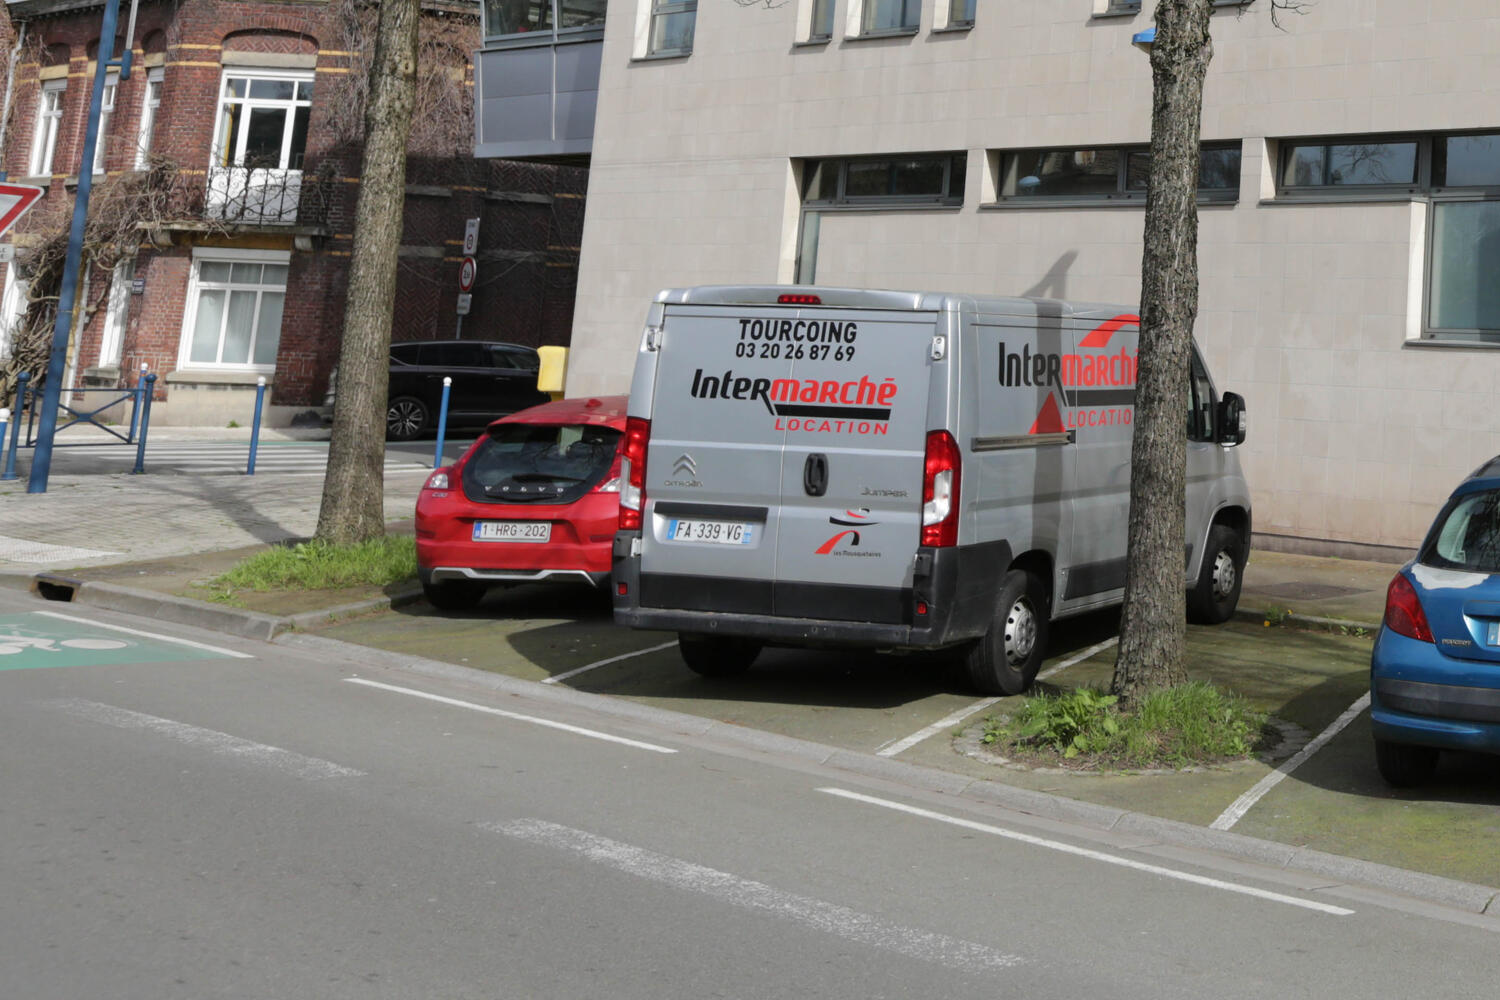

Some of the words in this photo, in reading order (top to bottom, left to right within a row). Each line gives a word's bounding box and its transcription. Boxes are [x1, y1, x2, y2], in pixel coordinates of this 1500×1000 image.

[739, 319, 857, 343] TOURCOING
[735, 342, 755, 358] 03
[760, 343, 780, 359] 20
[785, 344, 804, 360] 26
[809, 345, 830, 360] 87
[834, 346, 856, 361] 69
[774, 418, 888, 435] LOCATION
[1068, 409, 1132, 428] LOCATIO
